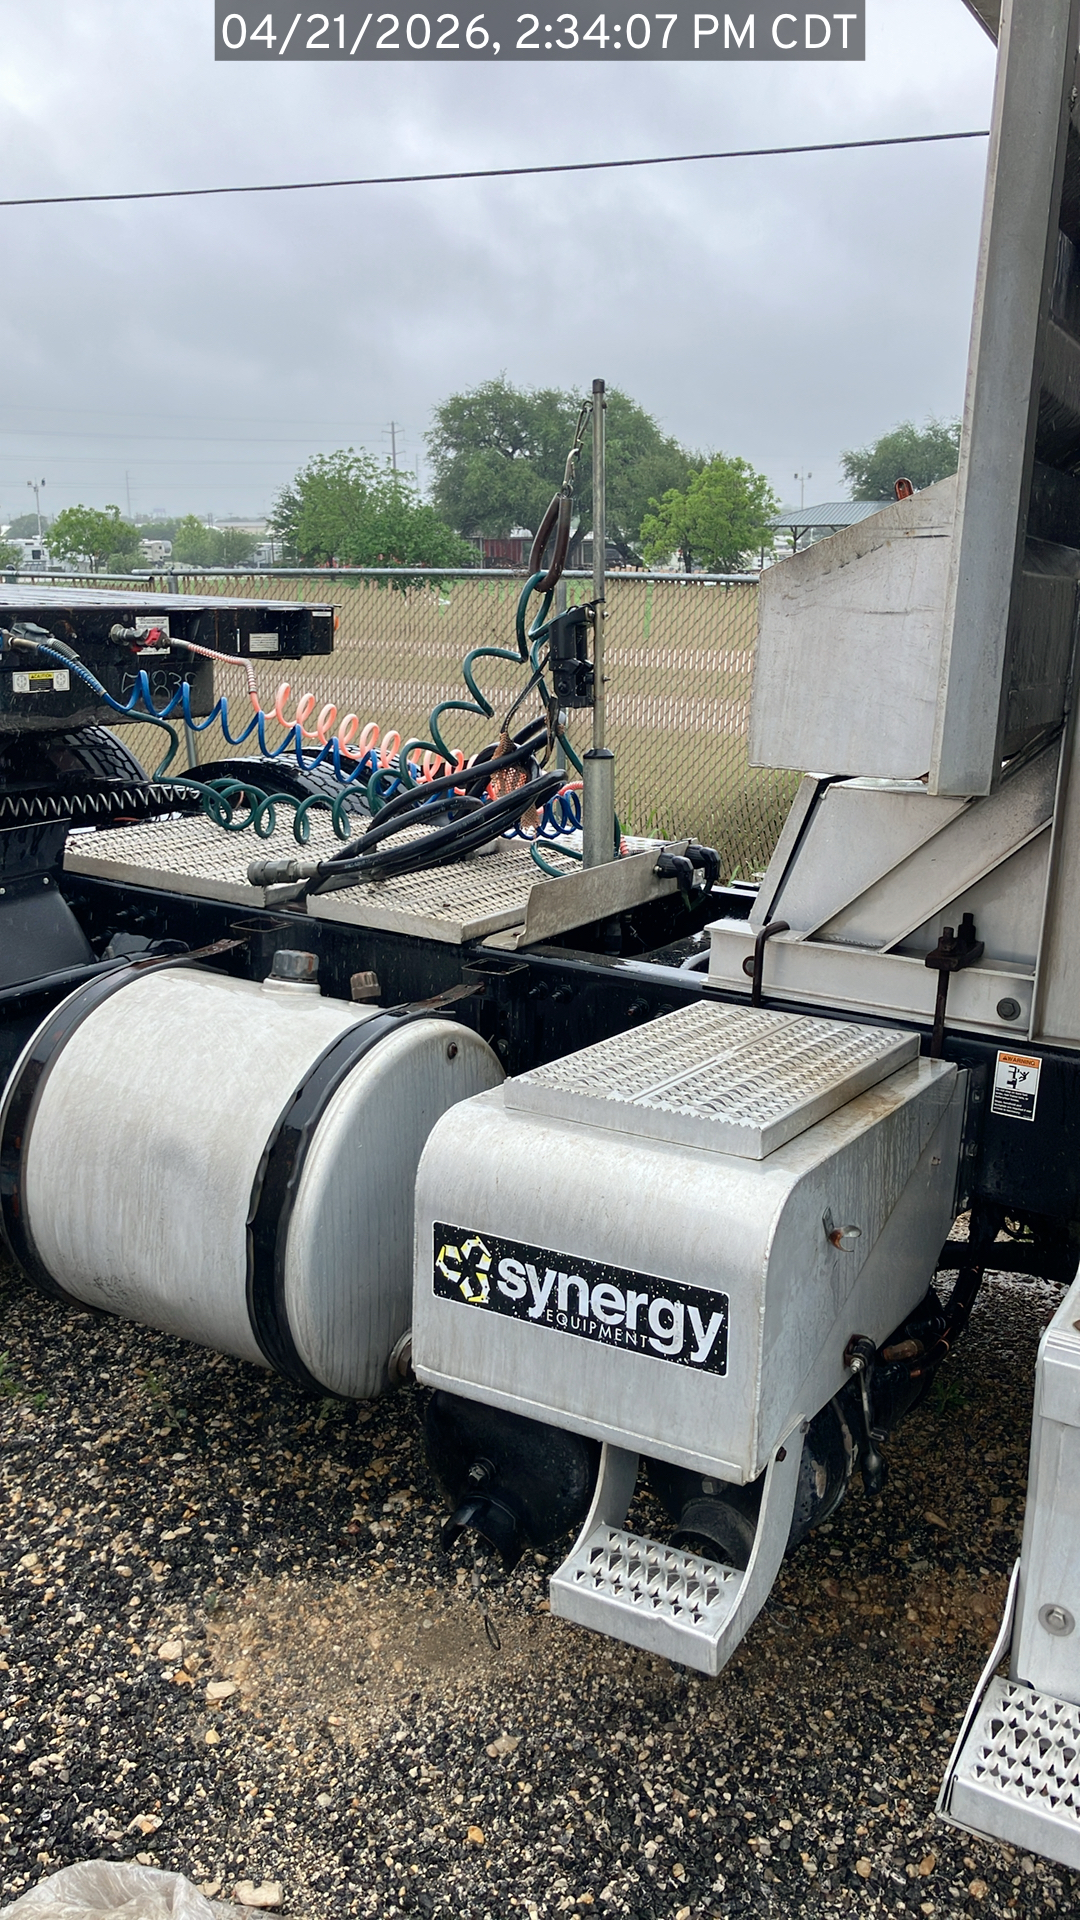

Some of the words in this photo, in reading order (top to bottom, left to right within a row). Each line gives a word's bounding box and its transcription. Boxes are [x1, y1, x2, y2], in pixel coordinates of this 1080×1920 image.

[1007, 1056, 1035, 1066] WARNING
[496, 1257, 724, 1363] synergy
[546, 1308, 649, 1348] EQUIPMENT
